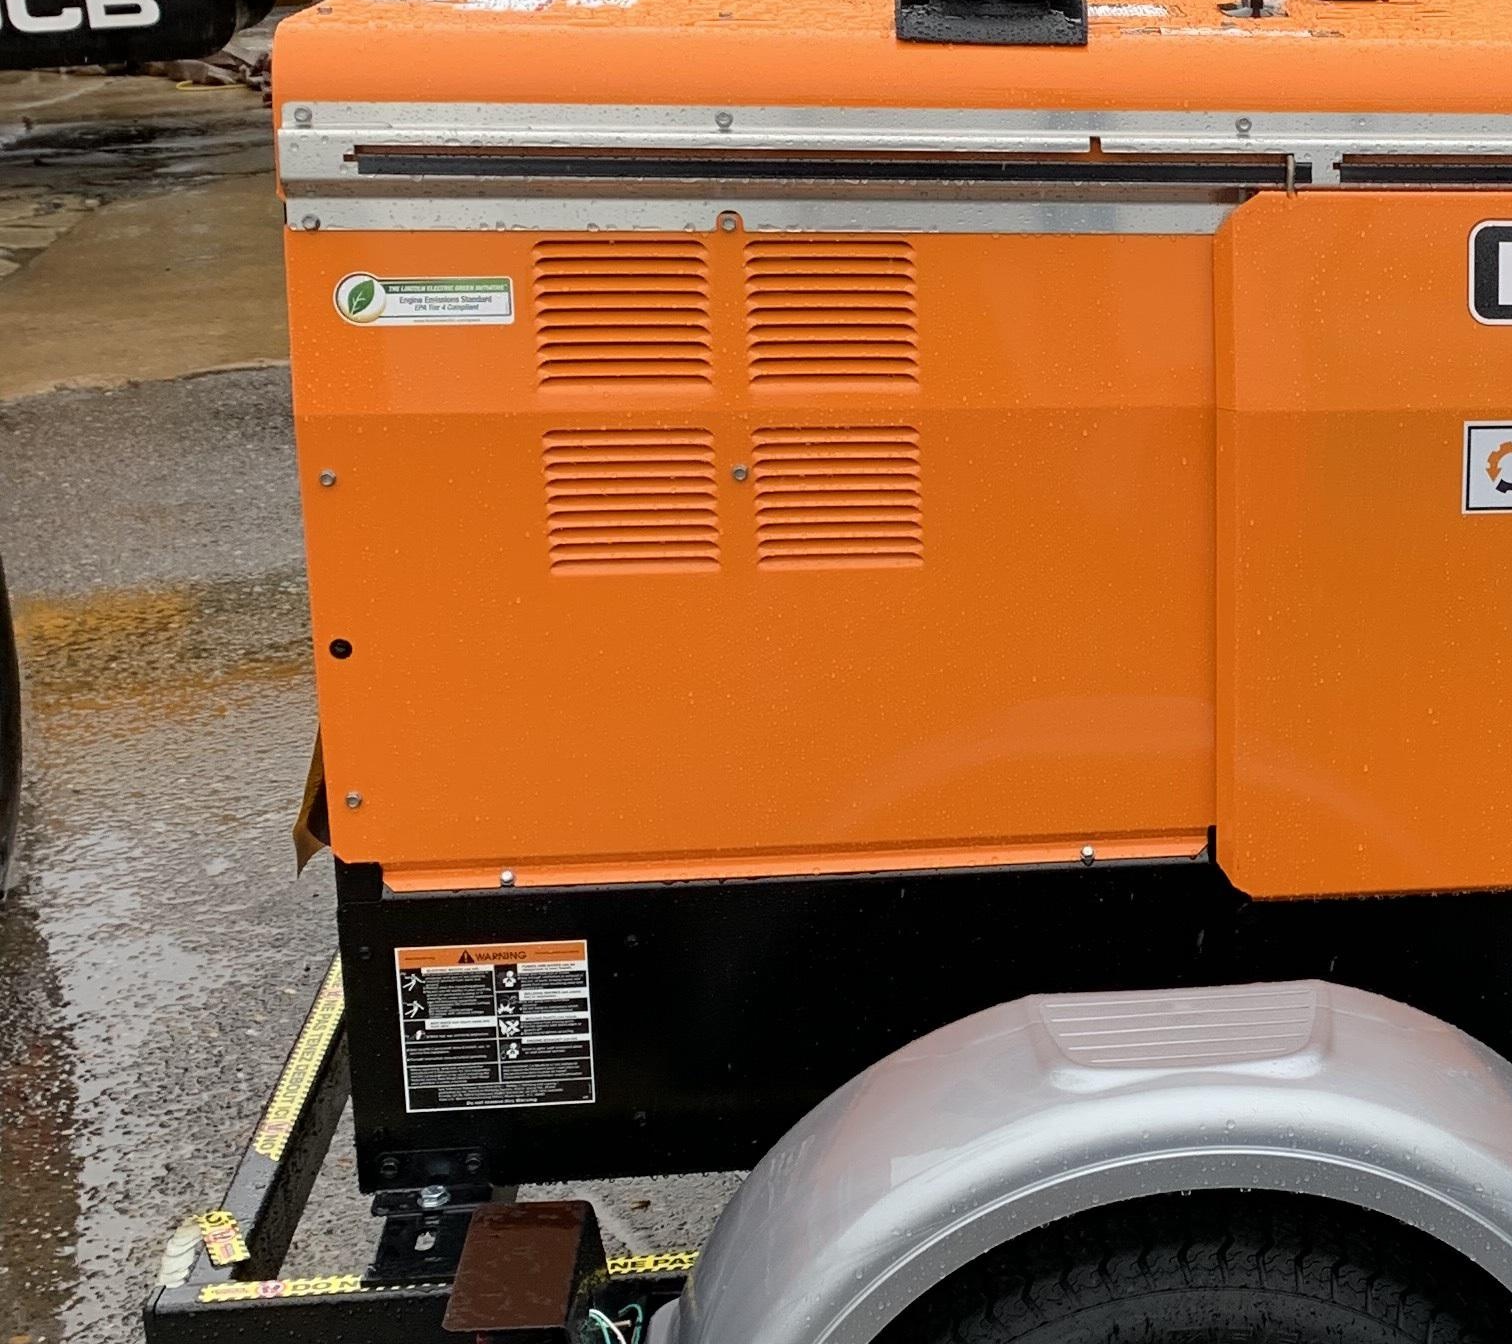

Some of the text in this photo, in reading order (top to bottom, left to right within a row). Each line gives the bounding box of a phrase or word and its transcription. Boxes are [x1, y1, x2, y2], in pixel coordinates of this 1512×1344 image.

[399, 294, 492, 305] Engine Emissions Standard
[475, 951, 527, 962] WARNING
[610, 1260, 647, 1270] NE
[292, 1280, 332, 1291] DO
